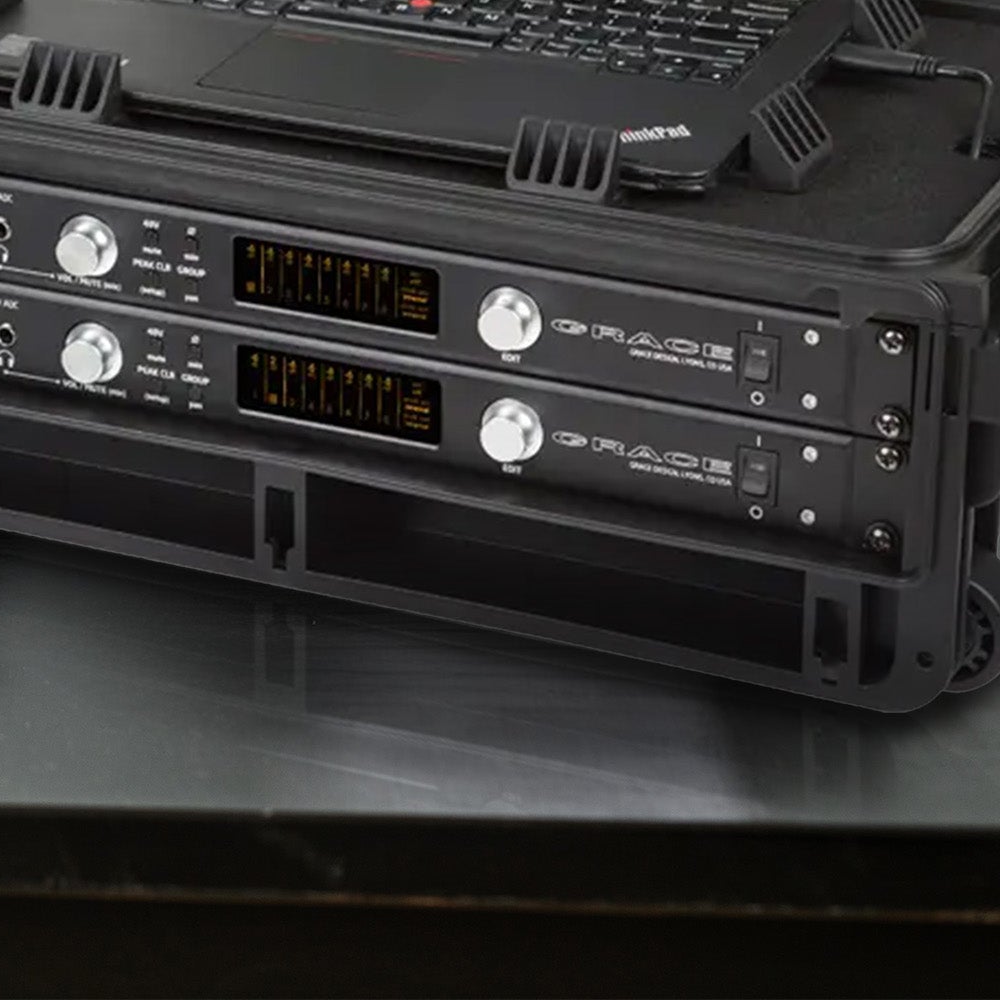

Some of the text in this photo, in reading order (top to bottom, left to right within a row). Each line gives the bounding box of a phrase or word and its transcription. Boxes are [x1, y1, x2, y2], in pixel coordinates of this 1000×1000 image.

[176, 264, 206, 278] GROUP
[551, 318, 734, 361] GRACE
[501, 352, 521, 364] EDIT
[180, 373, 210, 386] GROUP
[551, 430, 733, 475] GRACE
[502, 464, 523, 476] EDIT
